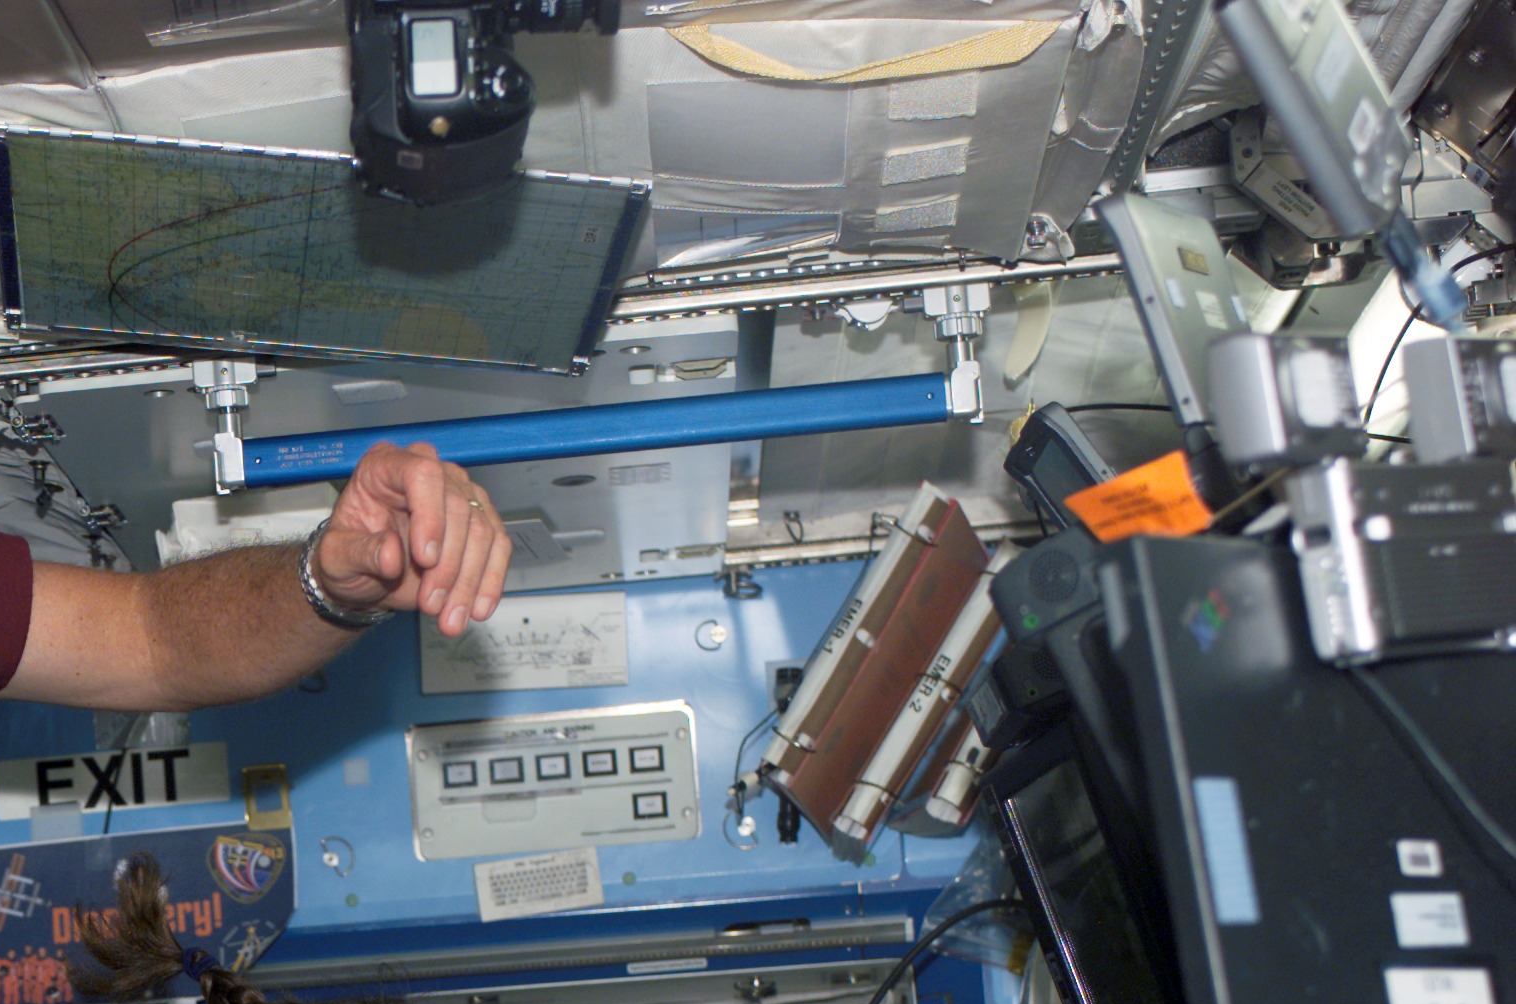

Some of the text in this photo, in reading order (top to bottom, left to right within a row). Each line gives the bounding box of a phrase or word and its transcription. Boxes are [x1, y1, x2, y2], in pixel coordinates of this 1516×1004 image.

[833, 599, 863, 639] EMER
[908, 654, 951, 713] EMER -2
[36, 749, 189, 808] EXIT
